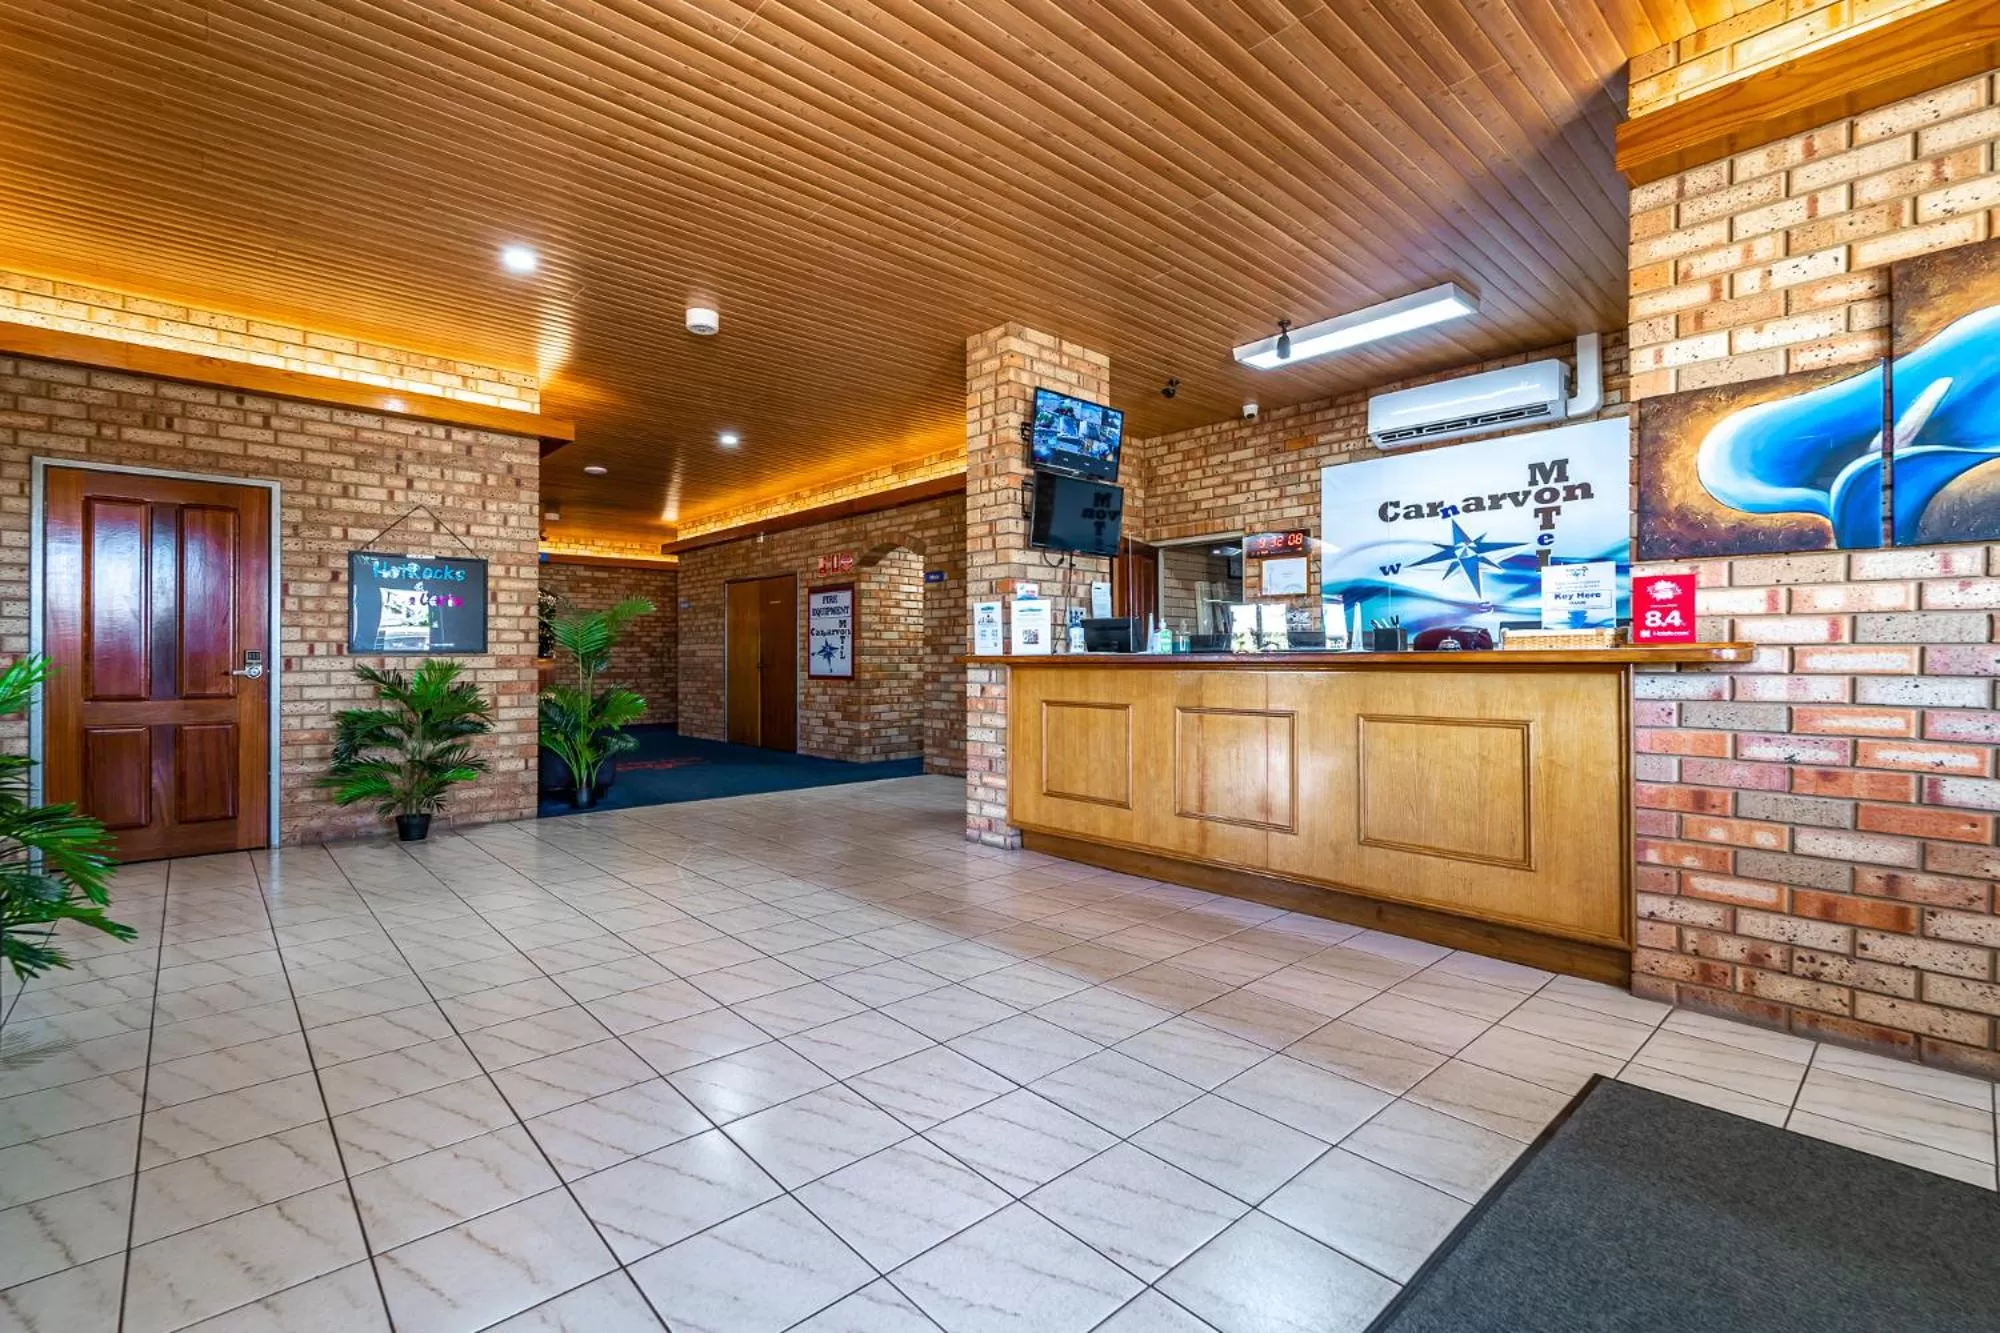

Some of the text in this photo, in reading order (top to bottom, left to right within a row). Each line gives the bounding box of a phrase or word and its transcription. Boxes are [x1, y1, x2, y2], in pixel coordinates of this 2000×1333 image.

[1378, 481, 1594, 523] Carnarvon
[822, 595, 839, 604] FIRE
[812, 606, 850, 617] EQUIPMENT
[1644, 609, 1683, 628] 8.4
